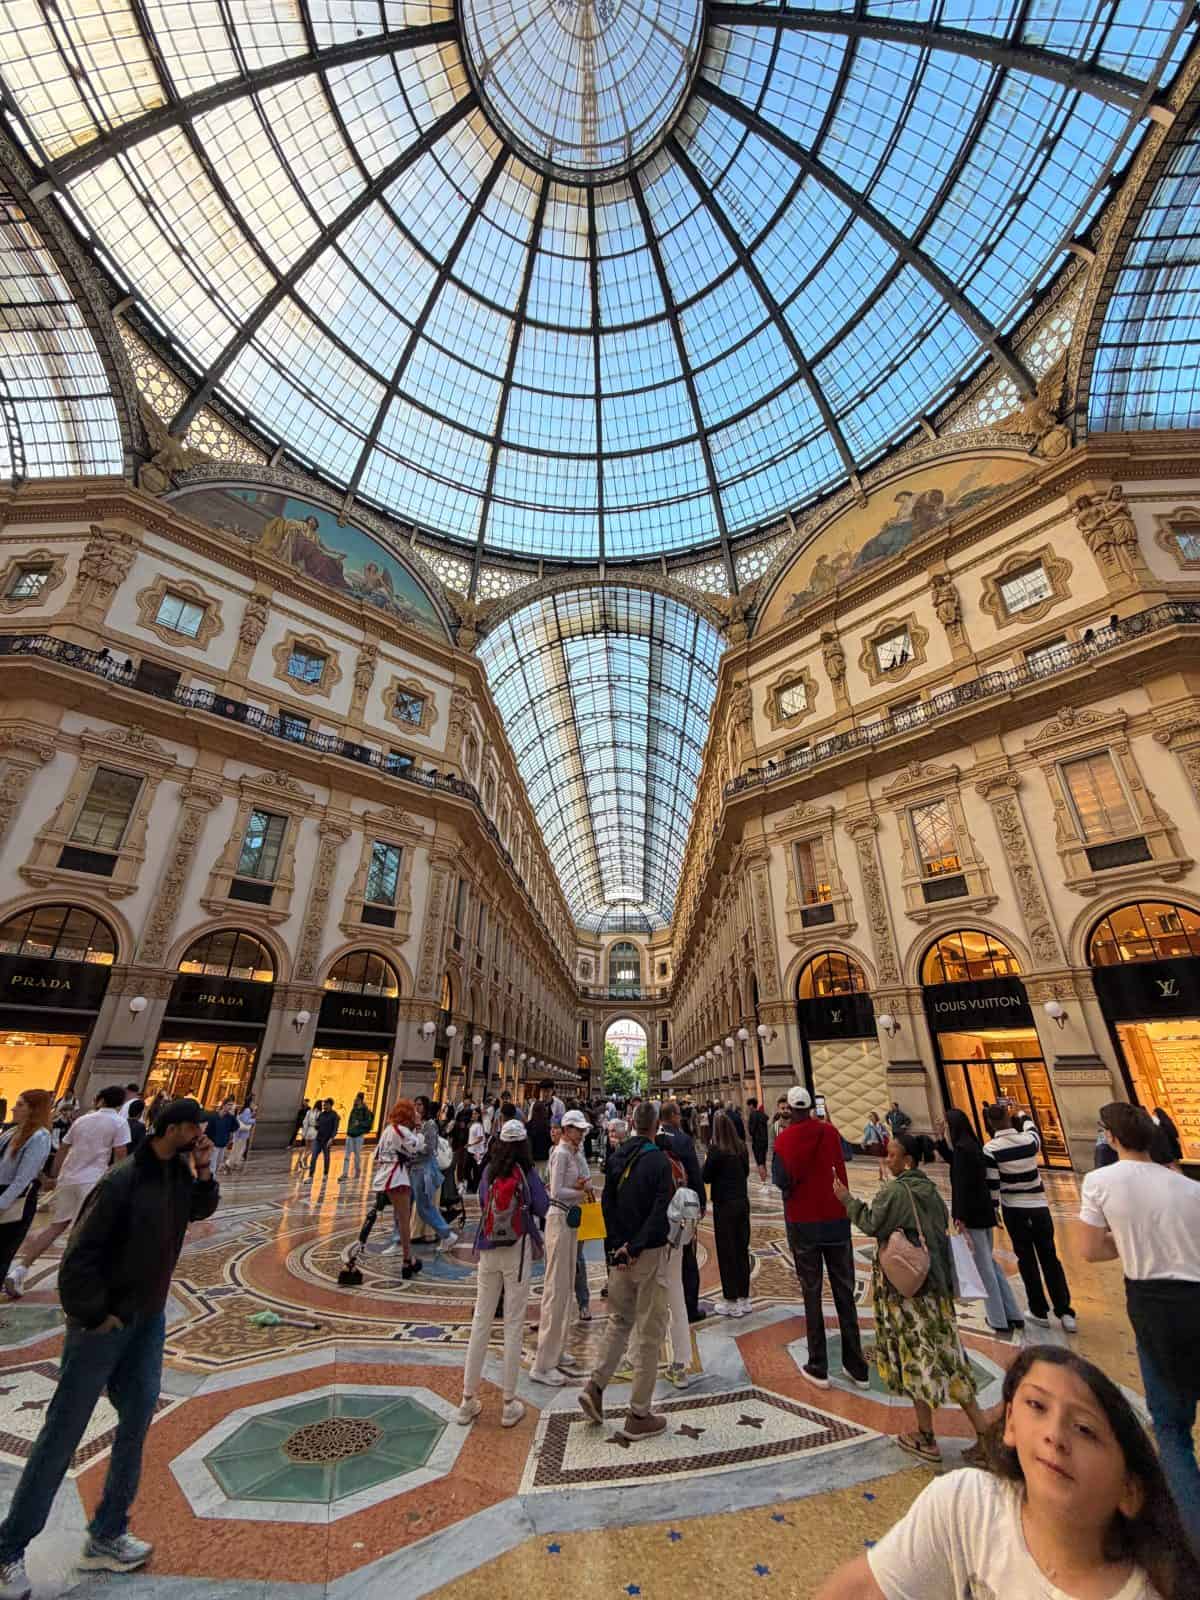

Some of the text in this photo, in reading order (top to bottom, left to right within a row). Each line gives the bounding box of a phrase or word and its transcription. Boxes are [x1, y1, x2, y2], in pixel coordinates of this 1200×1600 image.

[11, 975, 71, 990] PRADA
[199, 994, 244, 1007] PRADA
[935, 996, 1021, 1014] LOUIS VUITTON
[341, 1006, 378, 1018] PRADA
